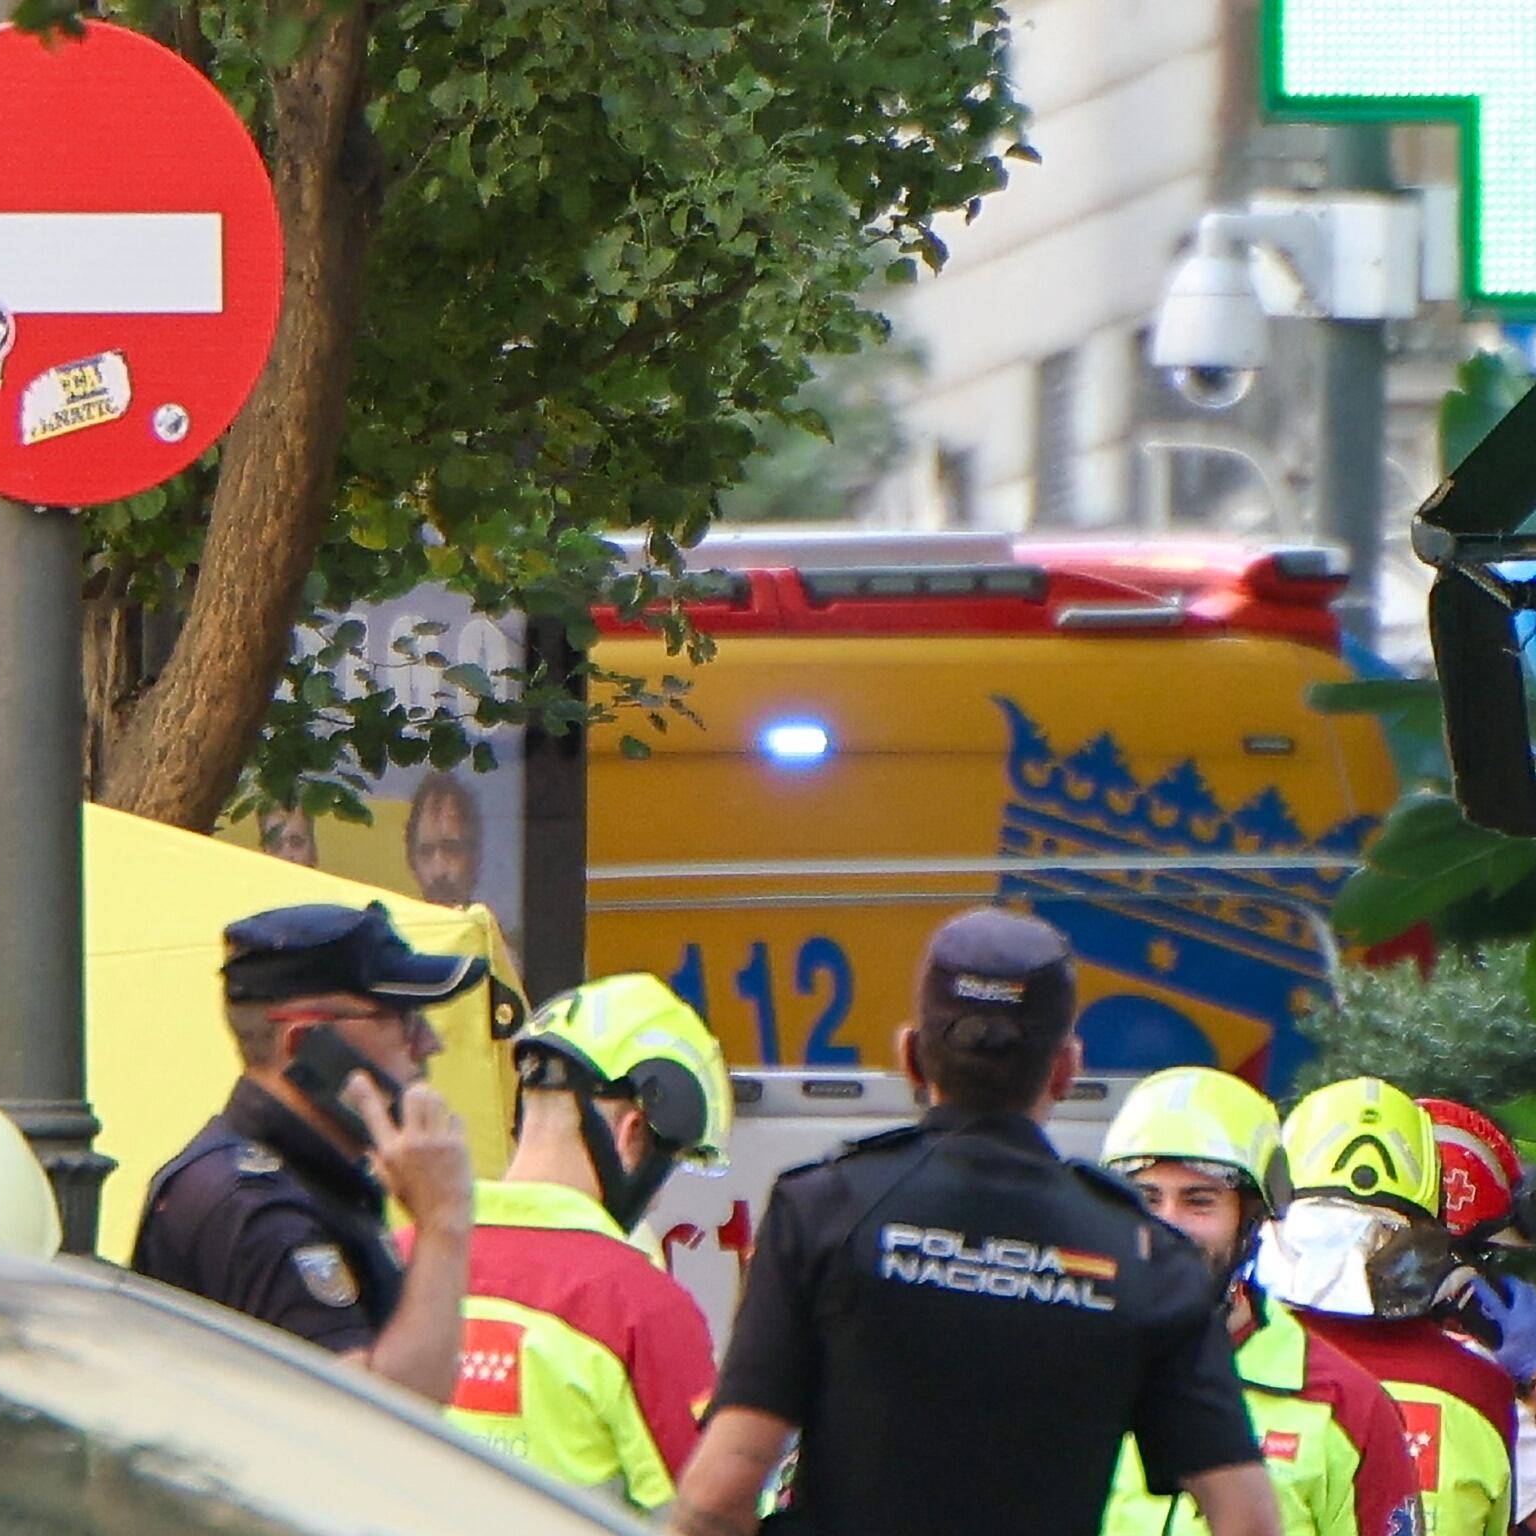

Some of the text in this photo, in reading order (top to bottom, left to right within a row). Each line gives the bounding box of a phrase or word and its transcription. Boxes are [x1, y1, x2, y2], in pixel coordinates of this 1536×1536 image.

[670, 936, 860, 1067] 112
[880, 1222, 1065, 1276] POLICIA
[880, 1253, 1116, 1311] NACIONAL
